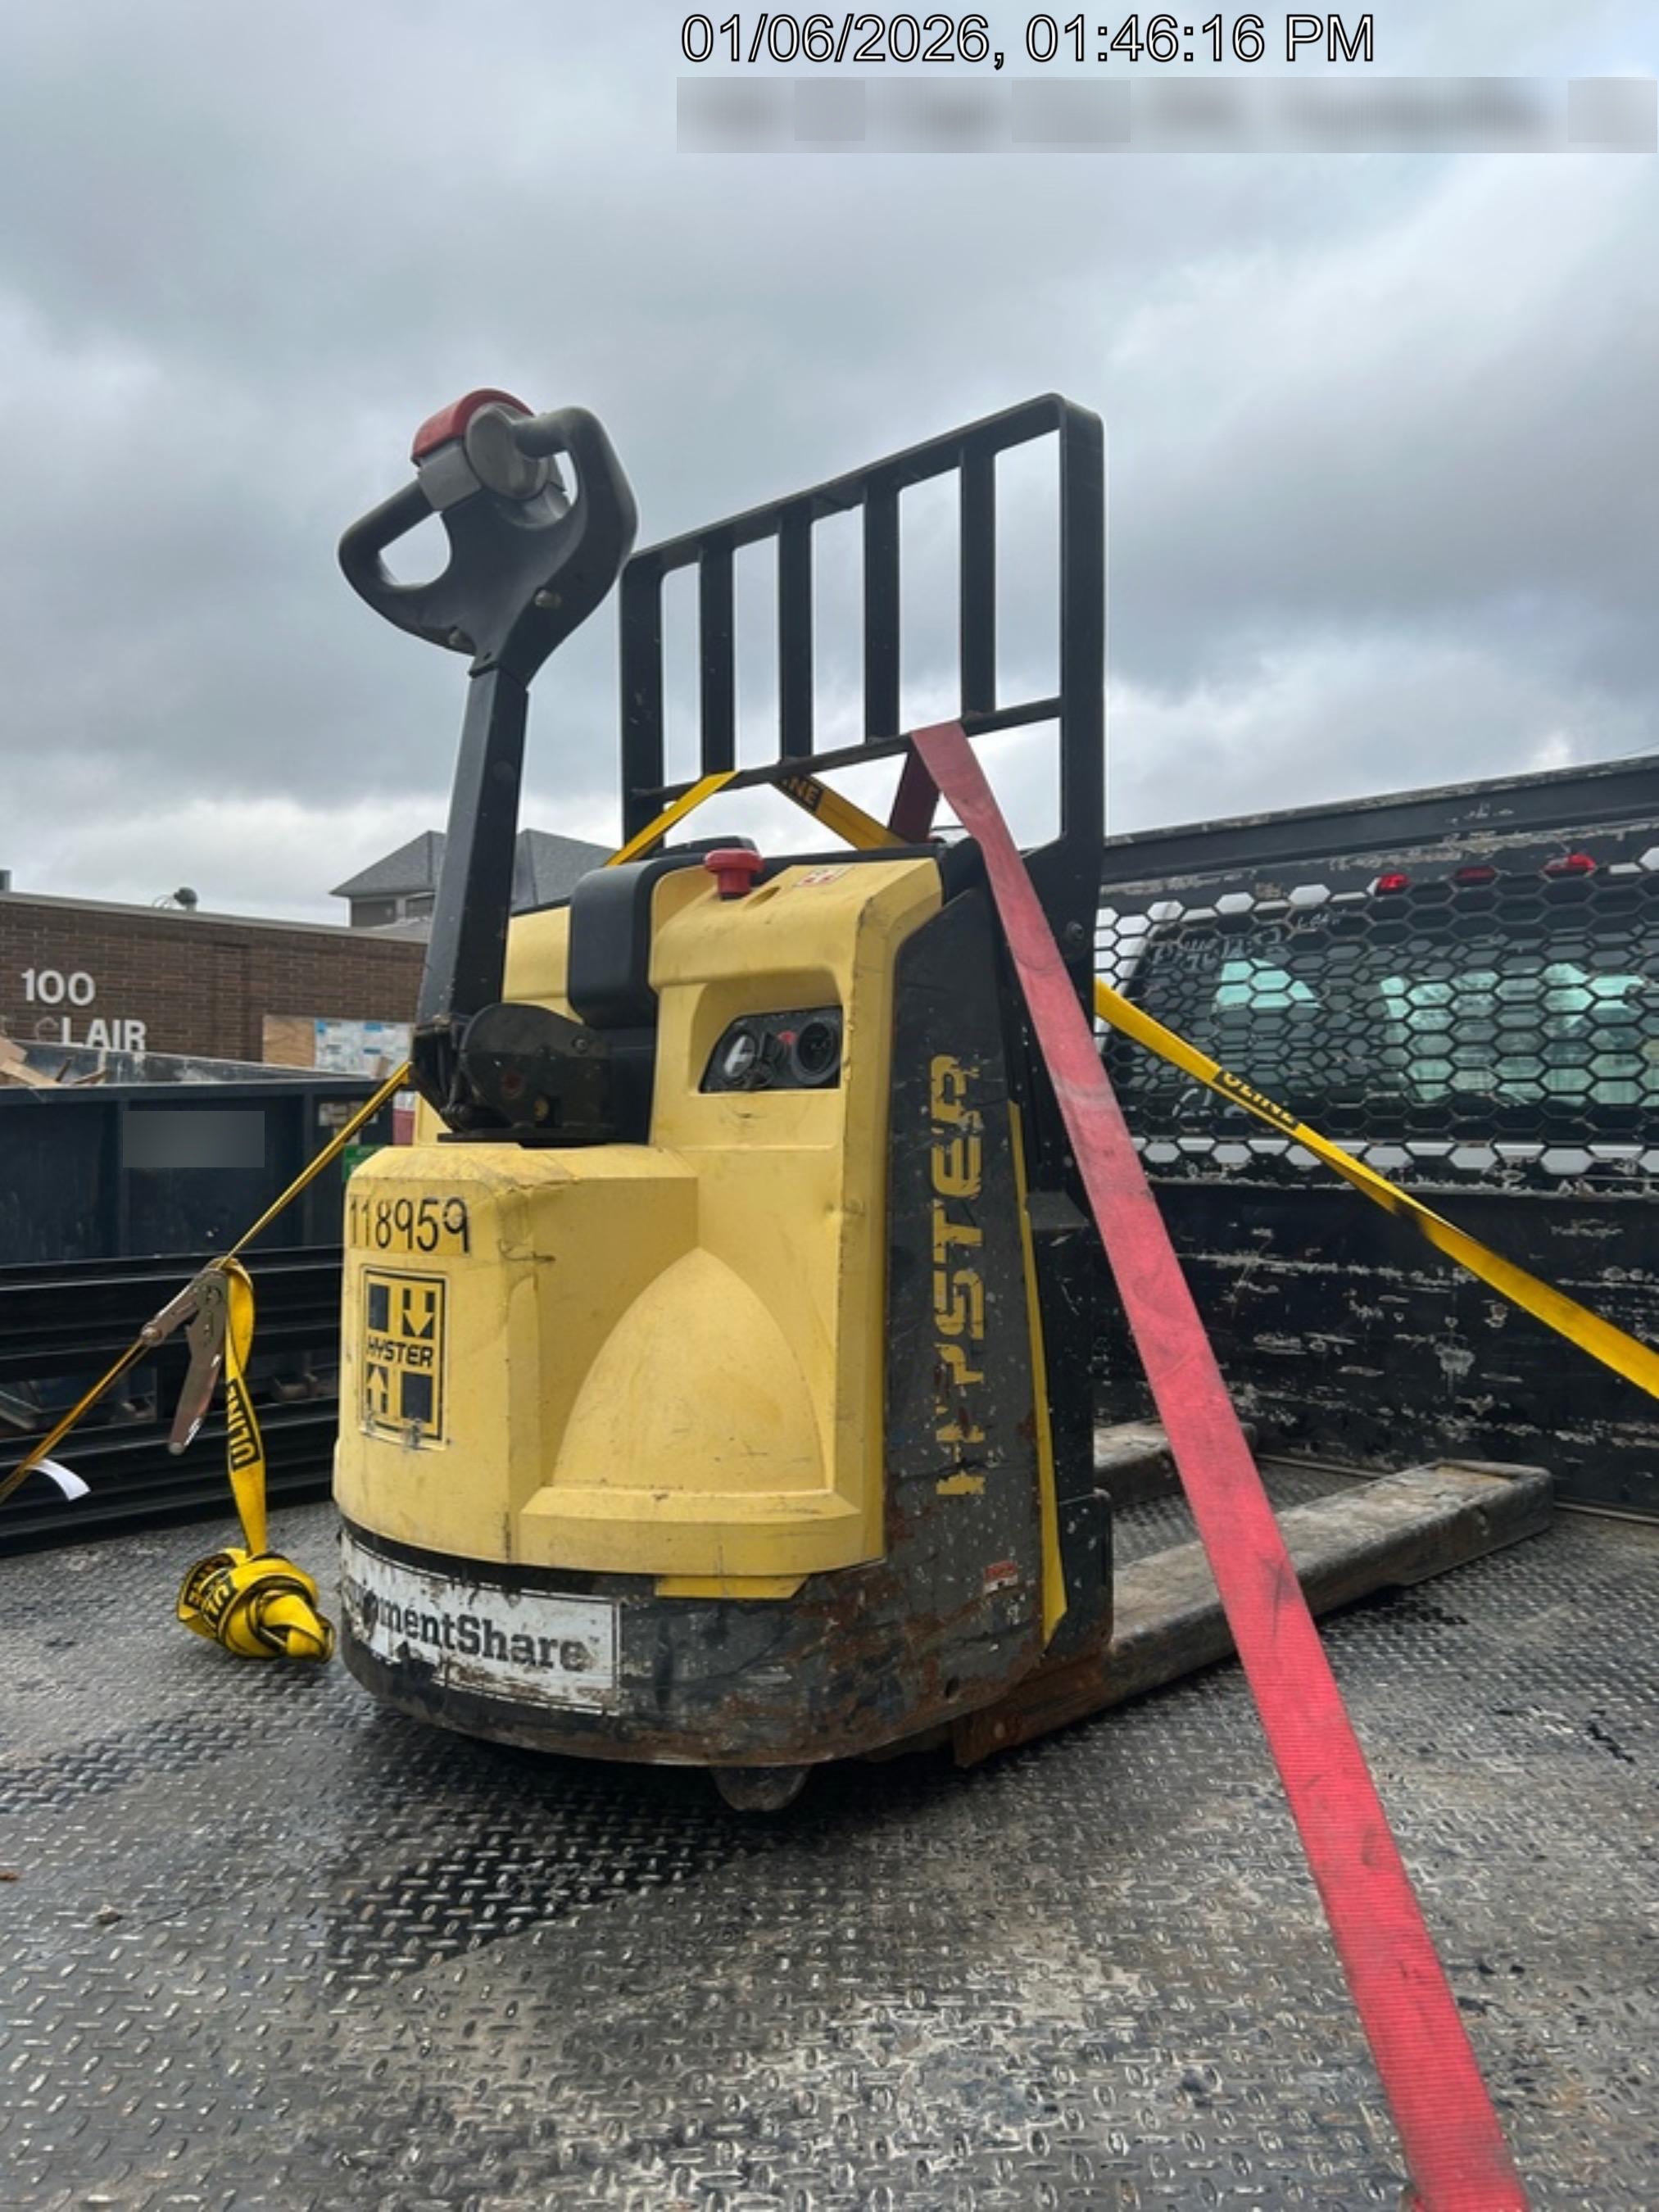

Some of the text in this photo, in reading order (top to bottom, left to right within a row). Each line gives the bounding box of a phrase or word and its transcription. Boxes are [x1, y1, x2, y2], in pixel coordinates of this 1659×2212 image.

[20, 968, 96, 1006] 100
[350, 1196, 470, 1253] 118959
[930, 1053, 986, 1495] HYSTER
[368, 1336, 434, 1367] HYSTER
[377, 1596, 590, 1672] mentShare
